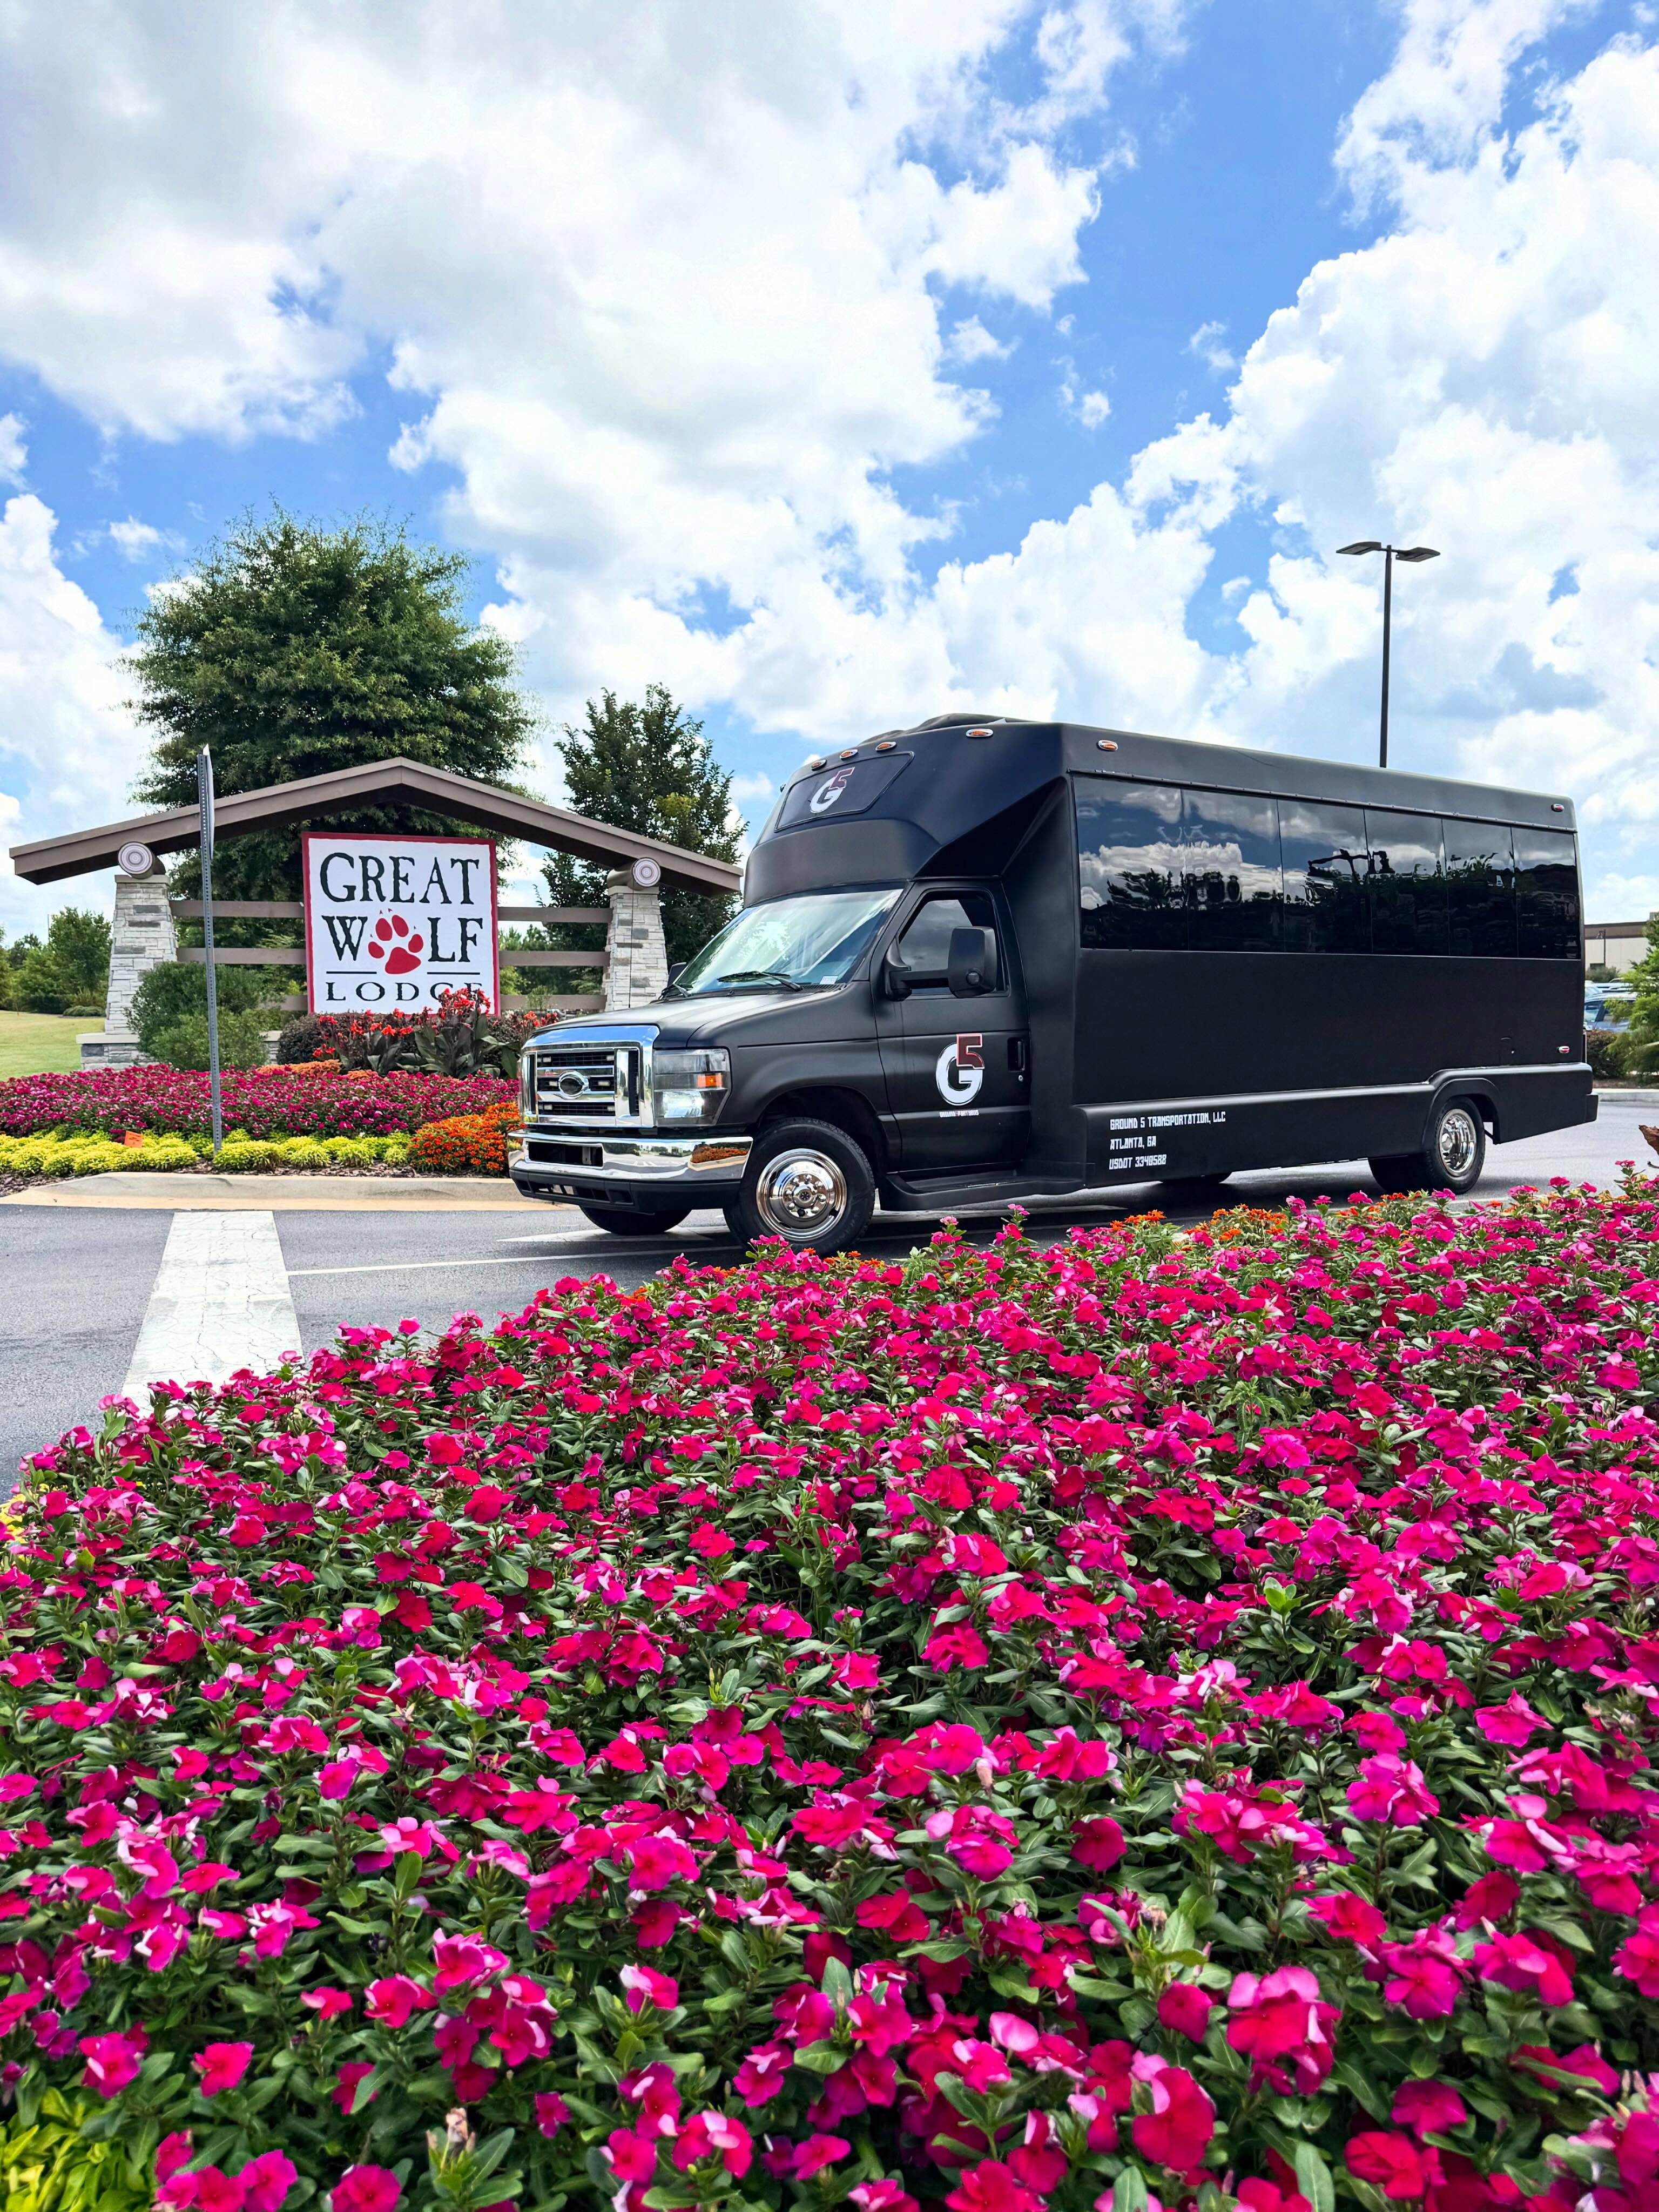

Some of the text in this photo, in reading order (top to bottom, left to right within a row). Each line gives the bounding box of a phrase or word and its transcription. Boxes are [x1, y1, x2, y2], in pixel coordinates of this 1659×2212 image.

[320, 852, 480, 905] GREAT
[321, 915, 483, 963] WLF
[1110, 1111, 1226, 1130] GROUND 5 TRANSPORTATION, LLC
[1110, 1136, 1156, 1150] ATLANTA, GA
[1109, 1154, 1167, 1170] USDOT 3340588
